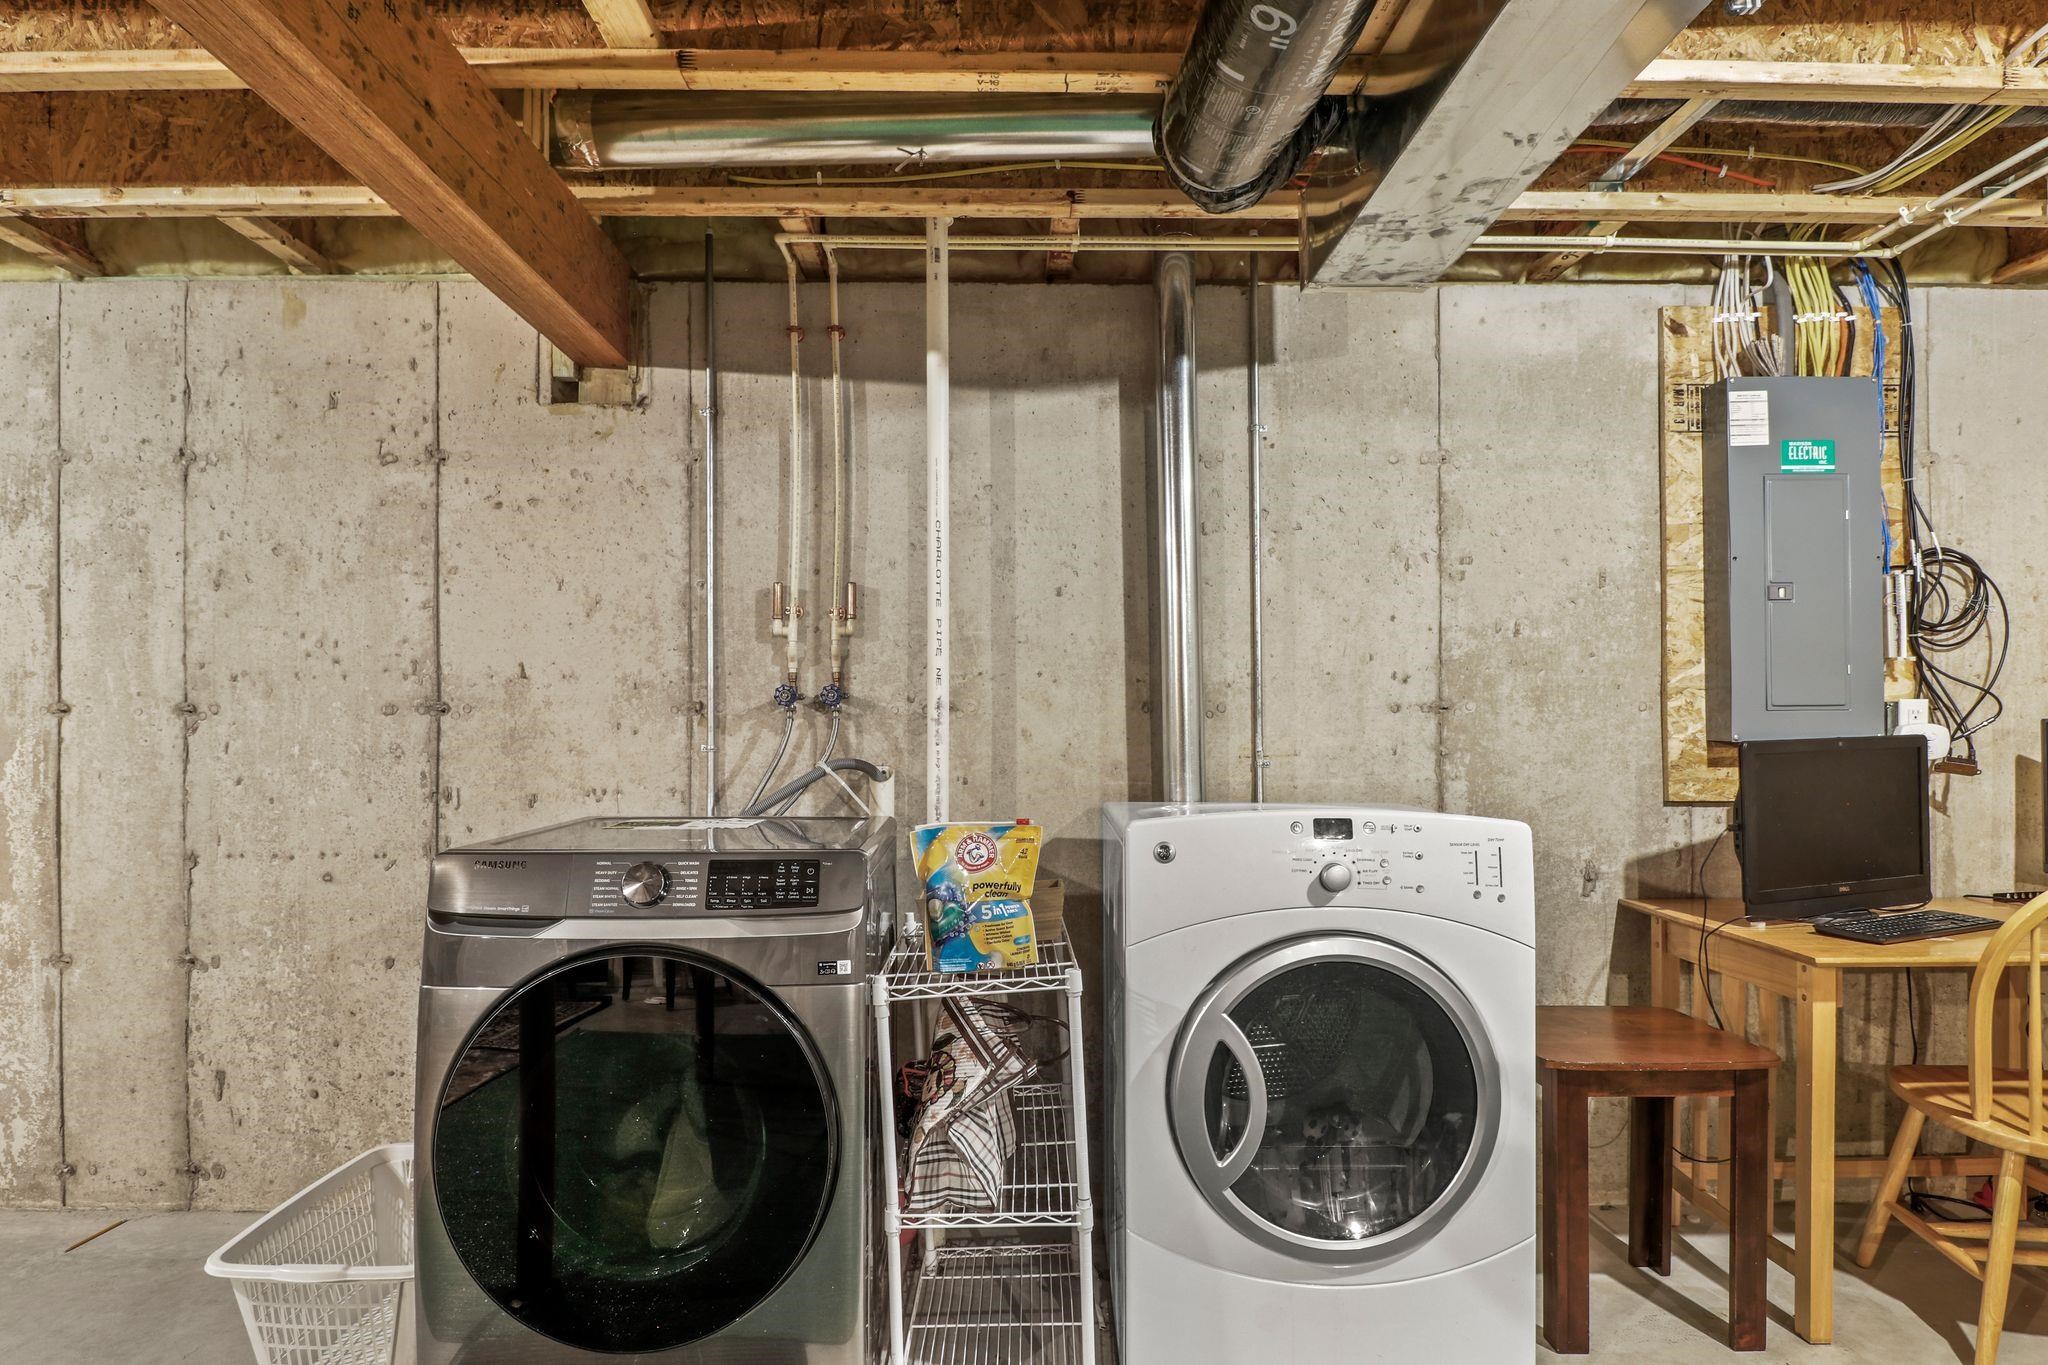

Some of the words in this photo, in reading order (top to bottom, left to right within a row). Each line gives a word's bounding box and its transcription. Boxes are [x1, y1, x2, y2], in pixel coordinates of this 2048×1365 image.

[1249, 3, 1298, 51] 6"
[1788, 445, 1828, 460] ELECTRIC
[934, 519, 942, 608] CHARLOTTE
[934, 617, 942, 657] PIPE
[957, 843, 967, 858] ARM
[972, 834, 995, 859] HAMMER
[474, 860, 528, 870] SAMSUNG
[972, 881, 1022, 893] powerfully
[984, 889, 1009, 898] clean
[981, 904, 993, 920] 5
